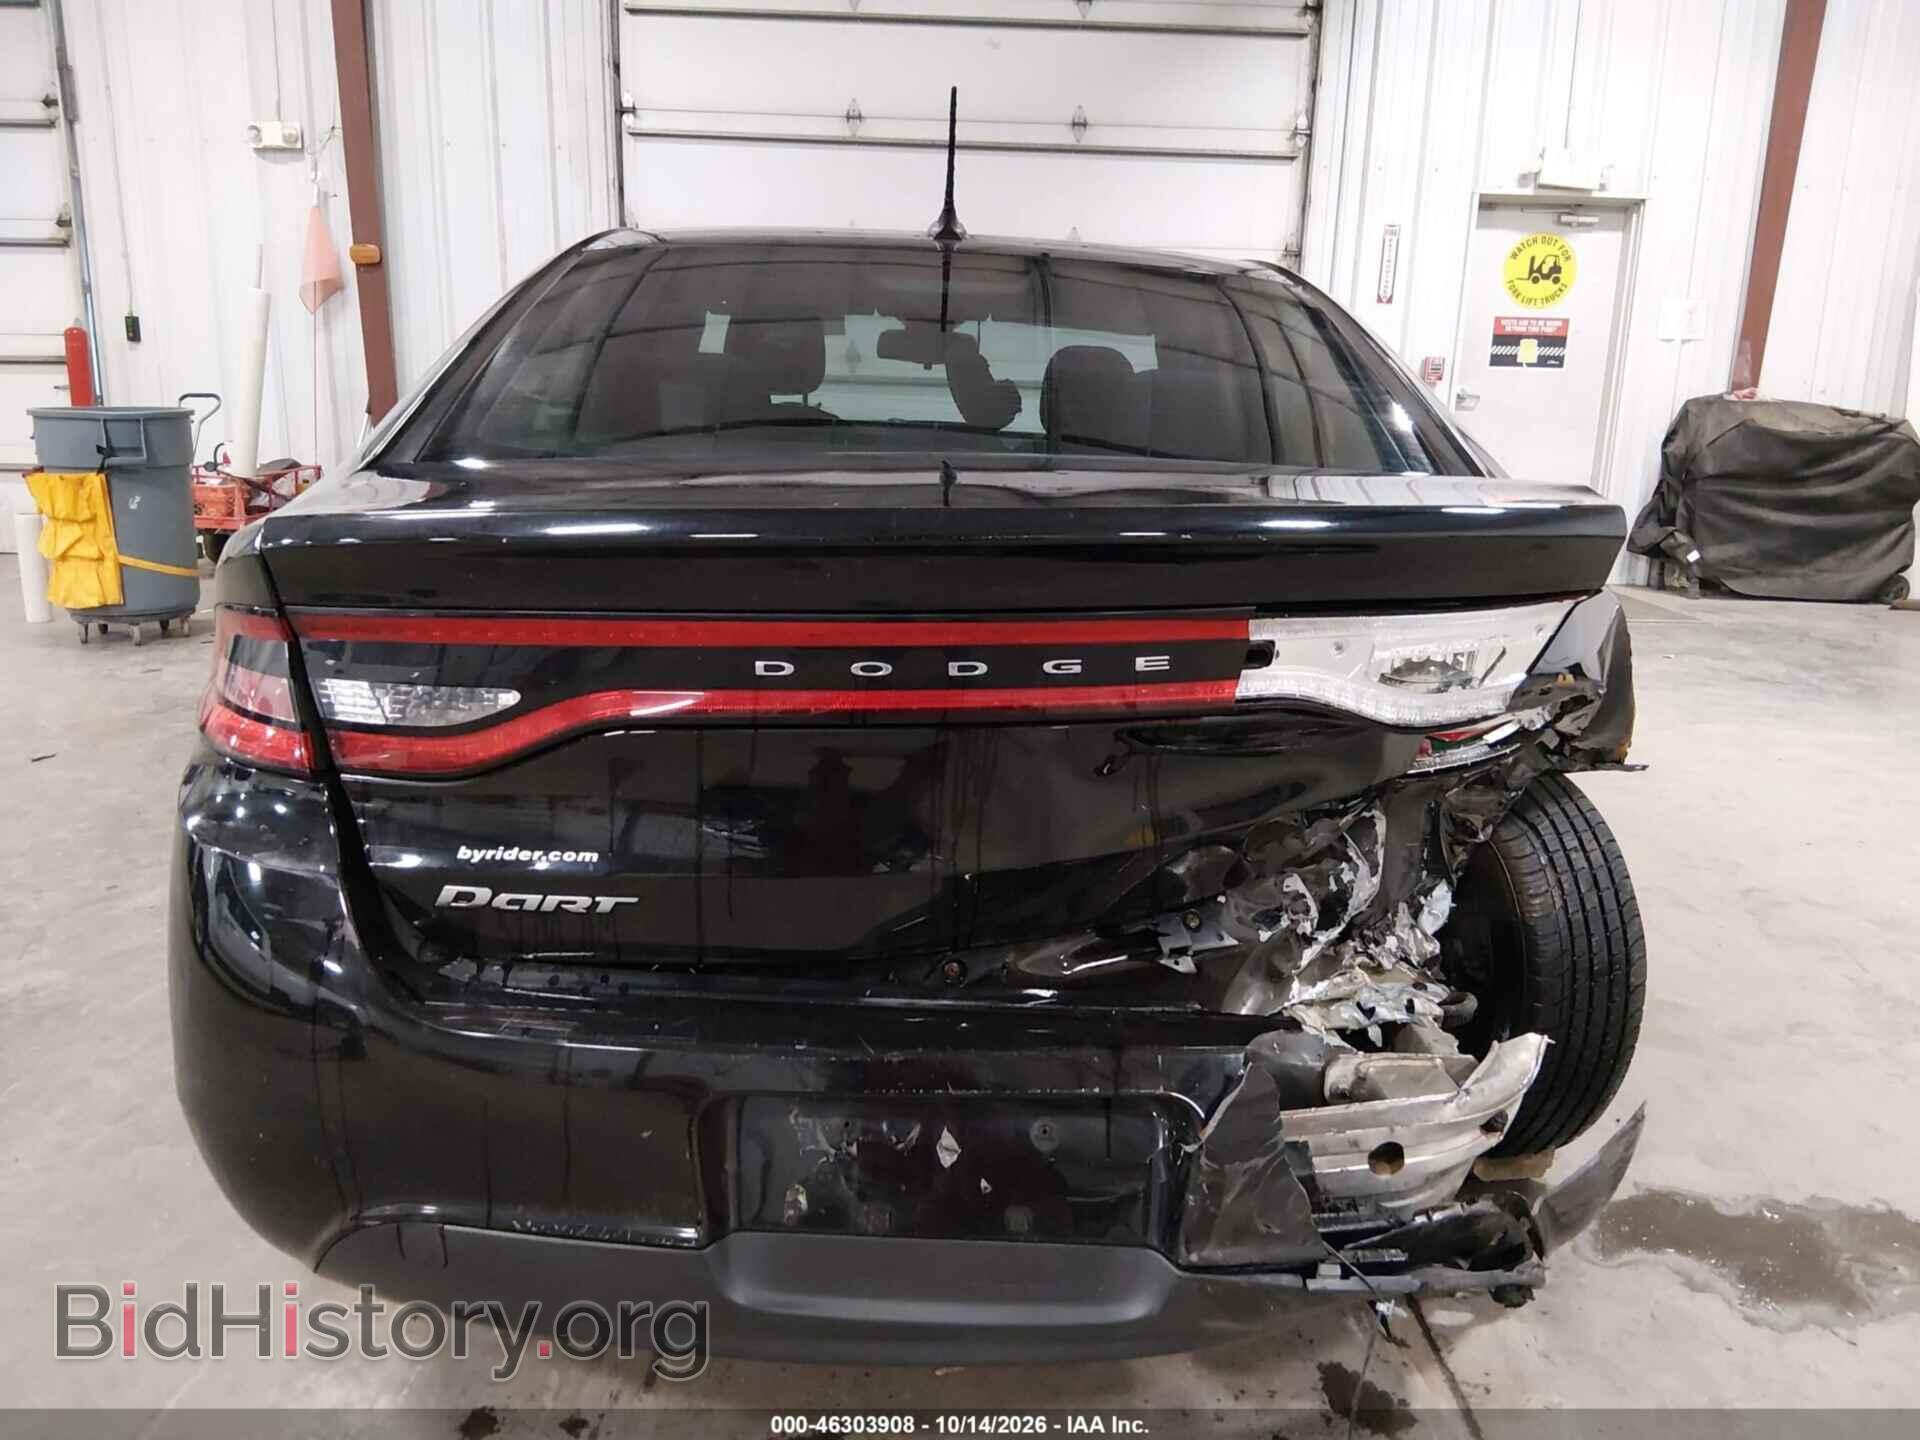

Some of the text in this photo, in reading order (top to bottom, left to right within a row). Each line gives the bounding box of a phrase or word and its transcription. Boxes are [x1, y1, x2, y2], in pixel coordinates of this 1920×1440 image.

[1509, 235, 1572, 262] WATCH OUT FOR
[1521, 295, 1537, 306] LIFT
[1540, 282, 1568, 305] TRUCKS
[755, 655, 1171, 677] DODGE
[456, 845, 599, 863] byrider.com
